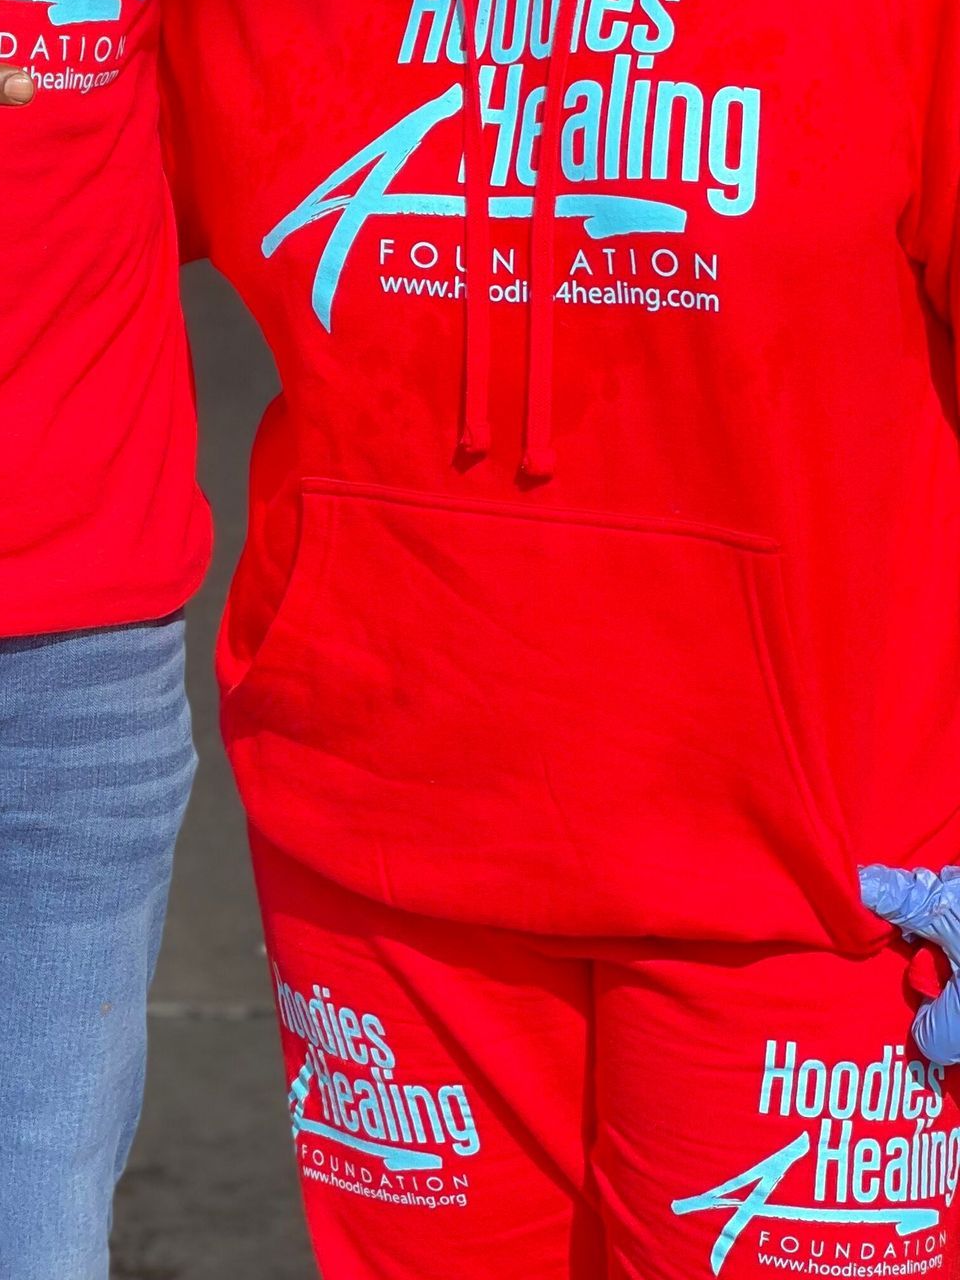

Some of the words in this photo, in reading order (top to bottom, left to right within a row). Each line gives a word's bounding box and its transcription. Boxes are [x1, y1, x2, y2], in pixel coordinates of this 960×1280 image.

[22, 65, 120, 95] healing.com
[458, 53, 761, 216] Healing
[261, 83, 688, 335] 4
[379, 239, 719, 281] FOUNATION
[379, 275, 720, 312] www.hodi4healing.com
[308, 1043, 480, 1156] Healing
[758, 1039, 945, 1120] Hoodies
[301, 1144, 468, 1190] FOUNDATION
[302, 1164, 467, 1208] www.hoodies4healing.org
[671, 1130, 939, 1277] 4
[814, 1118, 959, 1208] Healing
[757, 1250, 943, 1278] www.hoodies4healing.org
[758, 1229, 947, 1261] FOUNDATION
